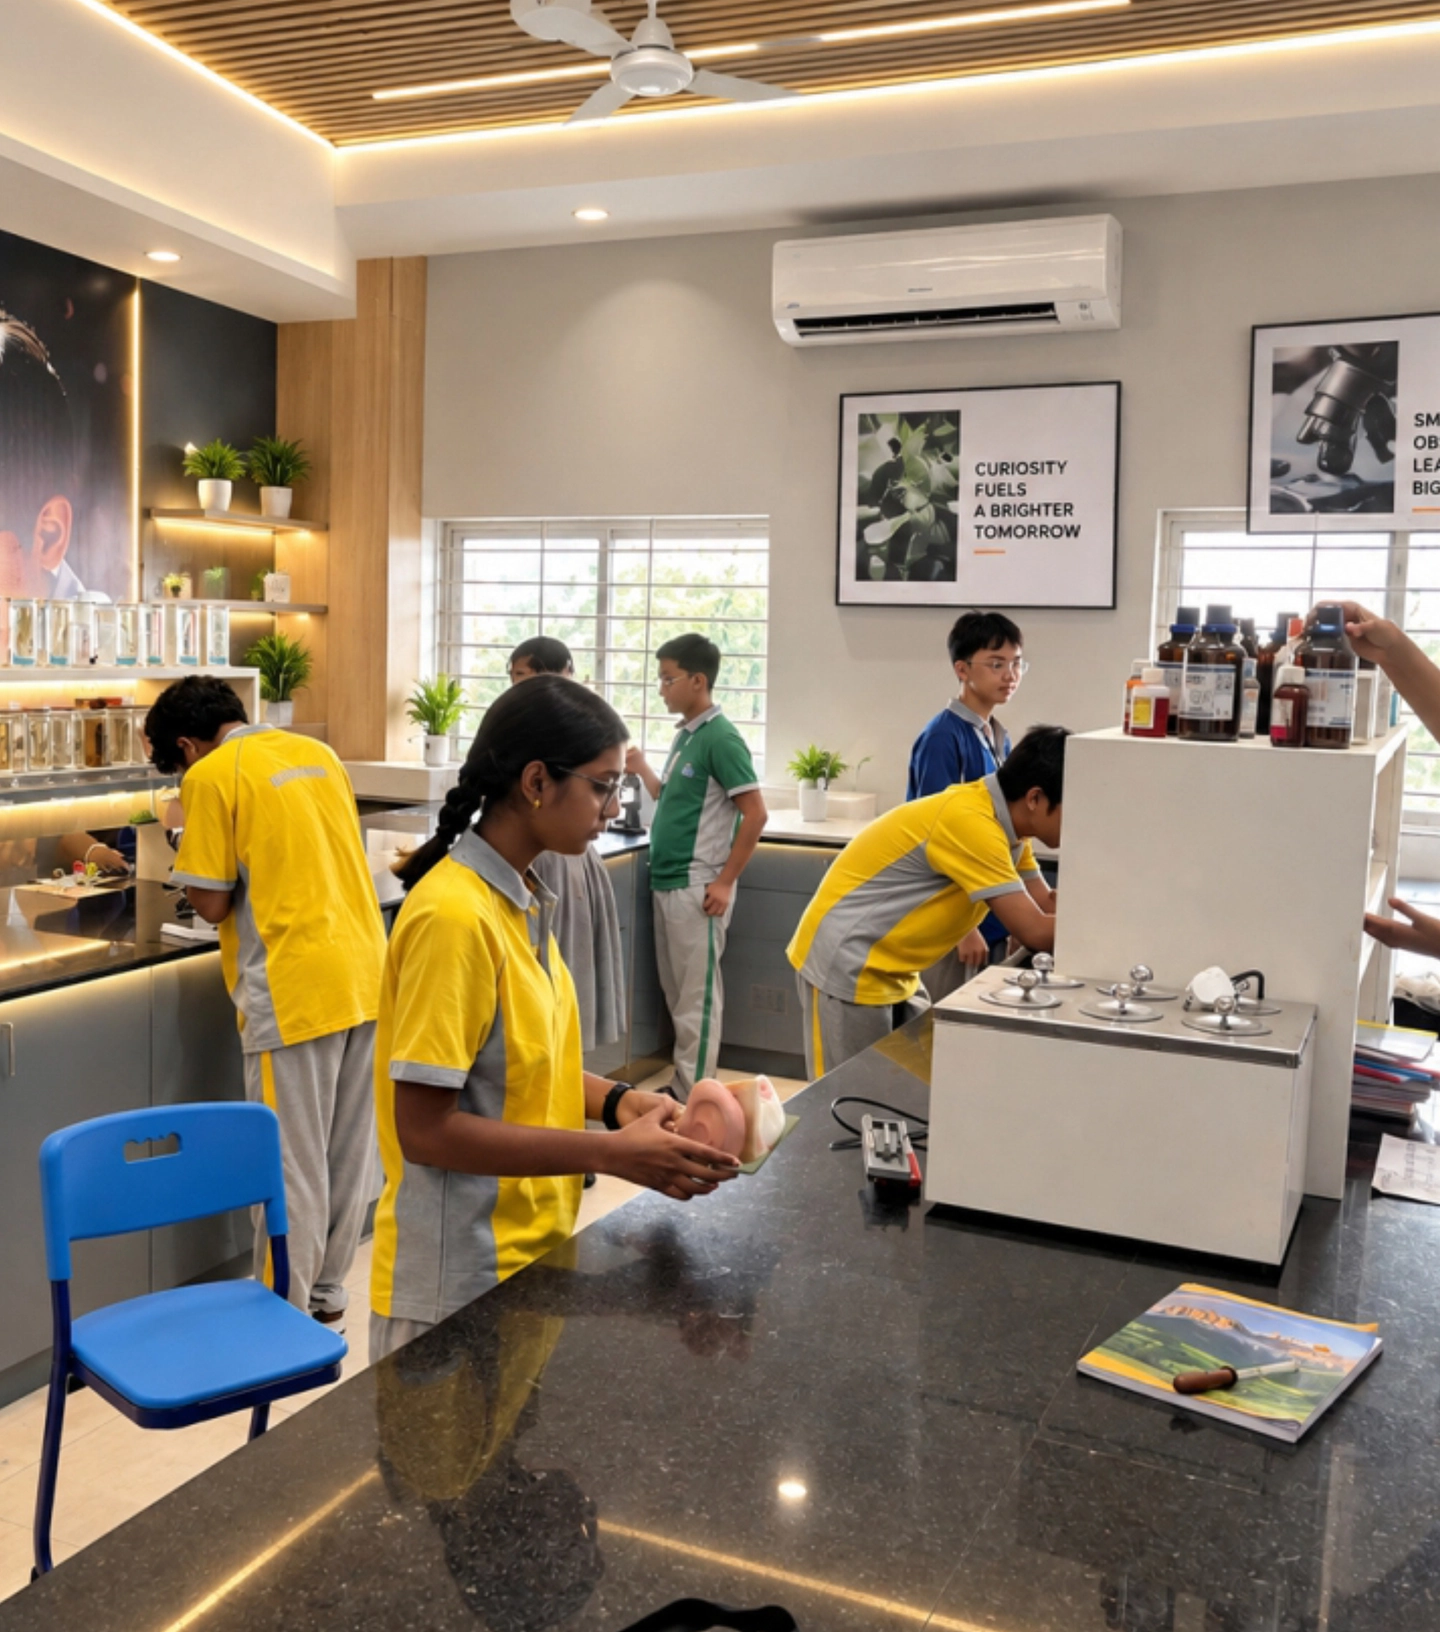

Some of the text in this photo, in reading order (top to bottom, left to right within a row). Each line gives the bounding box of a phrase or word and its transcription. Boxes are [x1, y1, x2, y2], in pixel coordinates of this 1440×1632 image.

[1413, 434, 1440, 451] OB
[974, 460, 1068, 477] CURIOSITY
[974, 481, 1027, 498] FUELS
[1412, 480, 1440, 495] BIG
[973, 502, 1074, 518] A BRIGHTER
[973, 524, 1081, 540] TOMORROW
